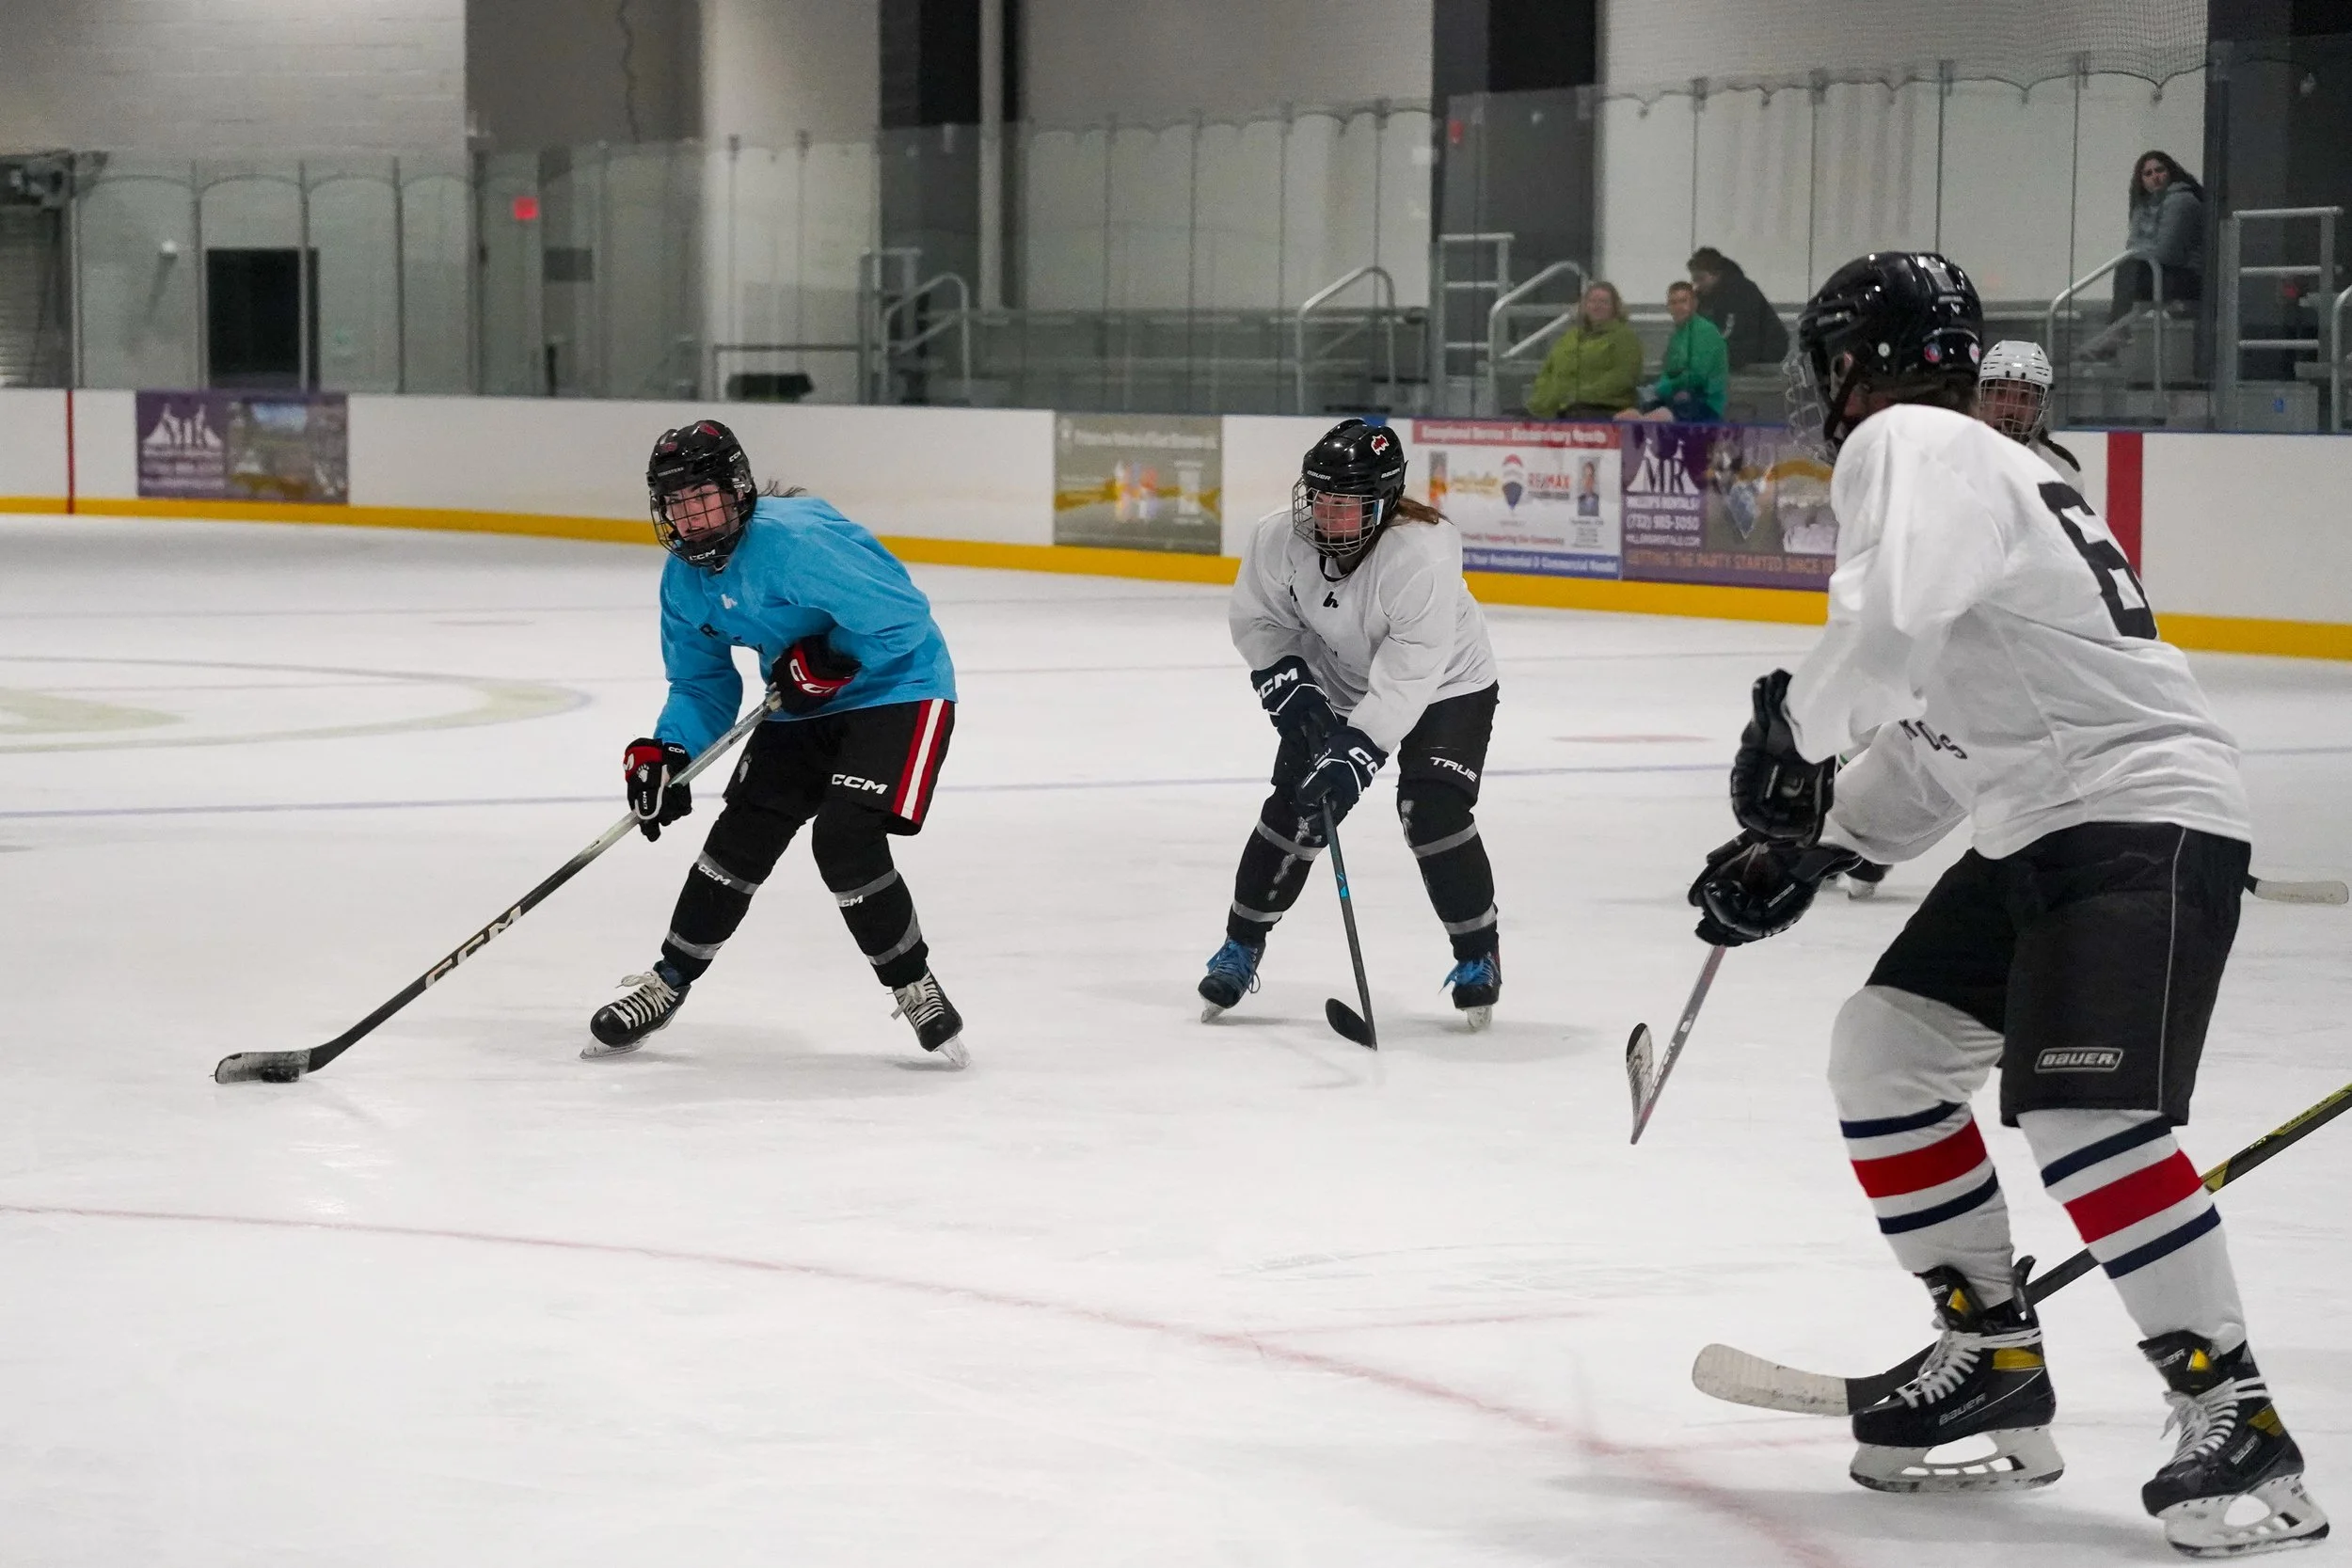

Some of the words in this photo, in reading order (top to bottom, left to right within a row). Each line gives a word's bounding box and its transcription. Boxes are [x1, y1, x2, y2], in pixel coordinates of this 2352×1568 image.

[789, 658, 835, 694] CC
[1255, 668, 1298, 699] CM
[1348, 747, 1378, 778] CC
[1430, 756, 1477, 782] TRUE
[832, 774, 888, 795] CCM
[698, 863, 732, 886] CCM
[2042, 1053, 2117, 1067] BAUER
[1939, 1393, 1987, 1426] BAUER
